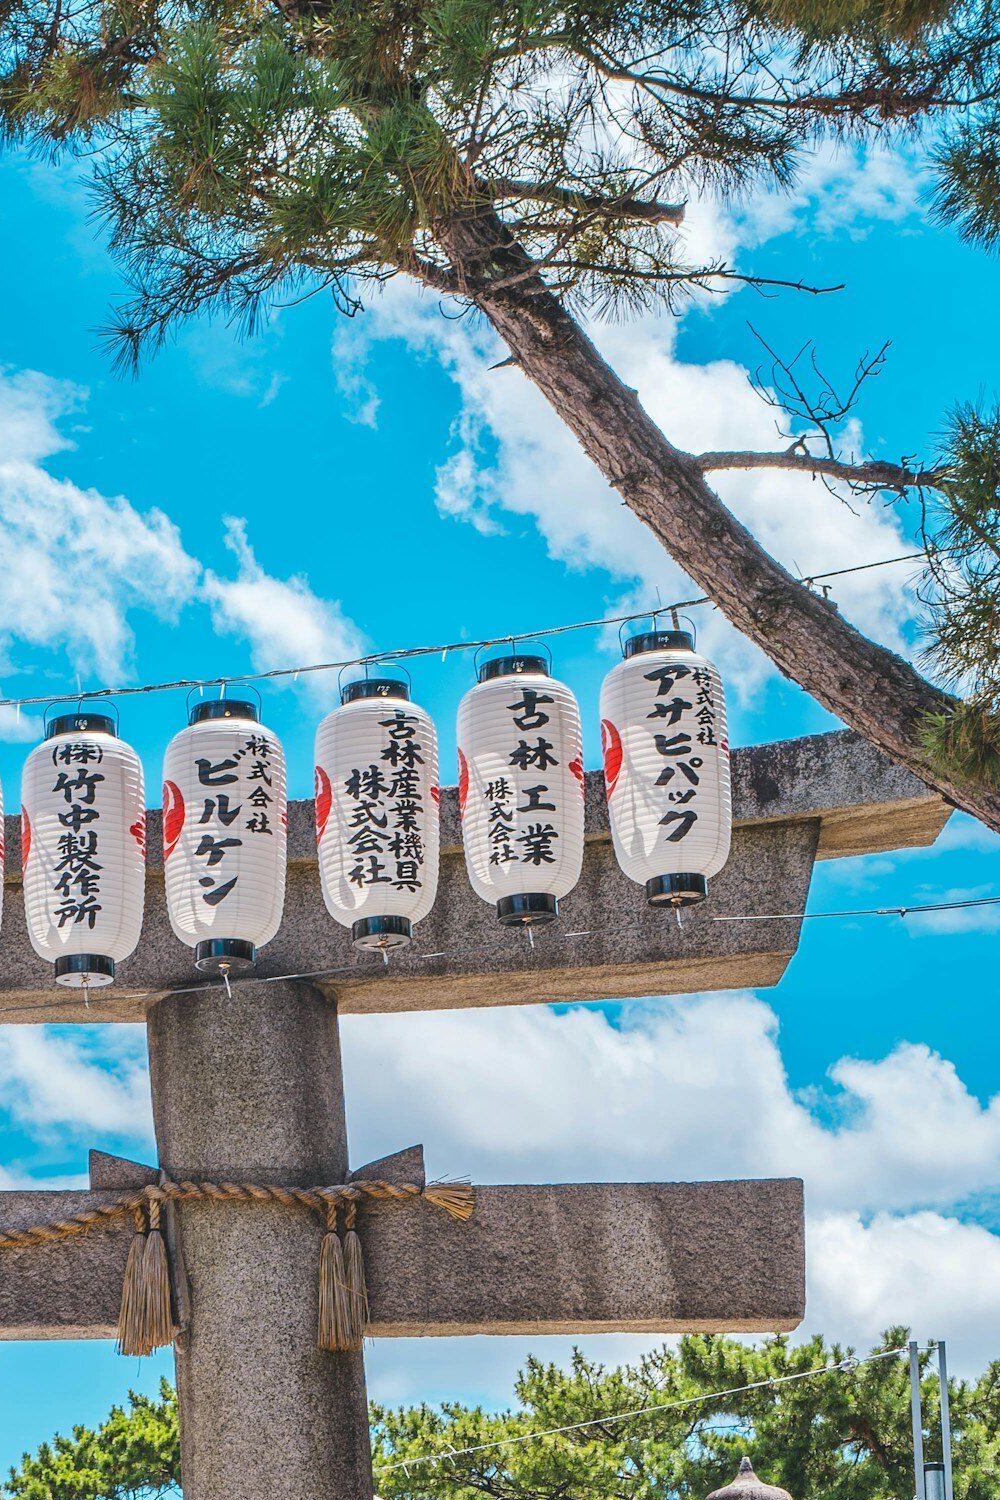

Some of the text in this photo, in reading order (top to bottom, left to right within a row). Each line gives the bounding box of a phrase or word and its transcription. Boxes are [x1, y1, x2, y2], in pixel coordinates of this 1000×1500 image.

[245, 734, 274, 836] 株式会社
[506, 688, 560, 867] 古林工業
[643, 664, 701, 843] アサヒパック
[691, 666, 718, 747] 株式会社
[51, 743, 106, 929] (株)竹中製作所
[194, 748, 247, 907] ビルケン
[344, 764, 392, 889] 株式会社
[377, 710, 426, 893] 古林産業機具
[484, 776, 519, 867] 株式会社
